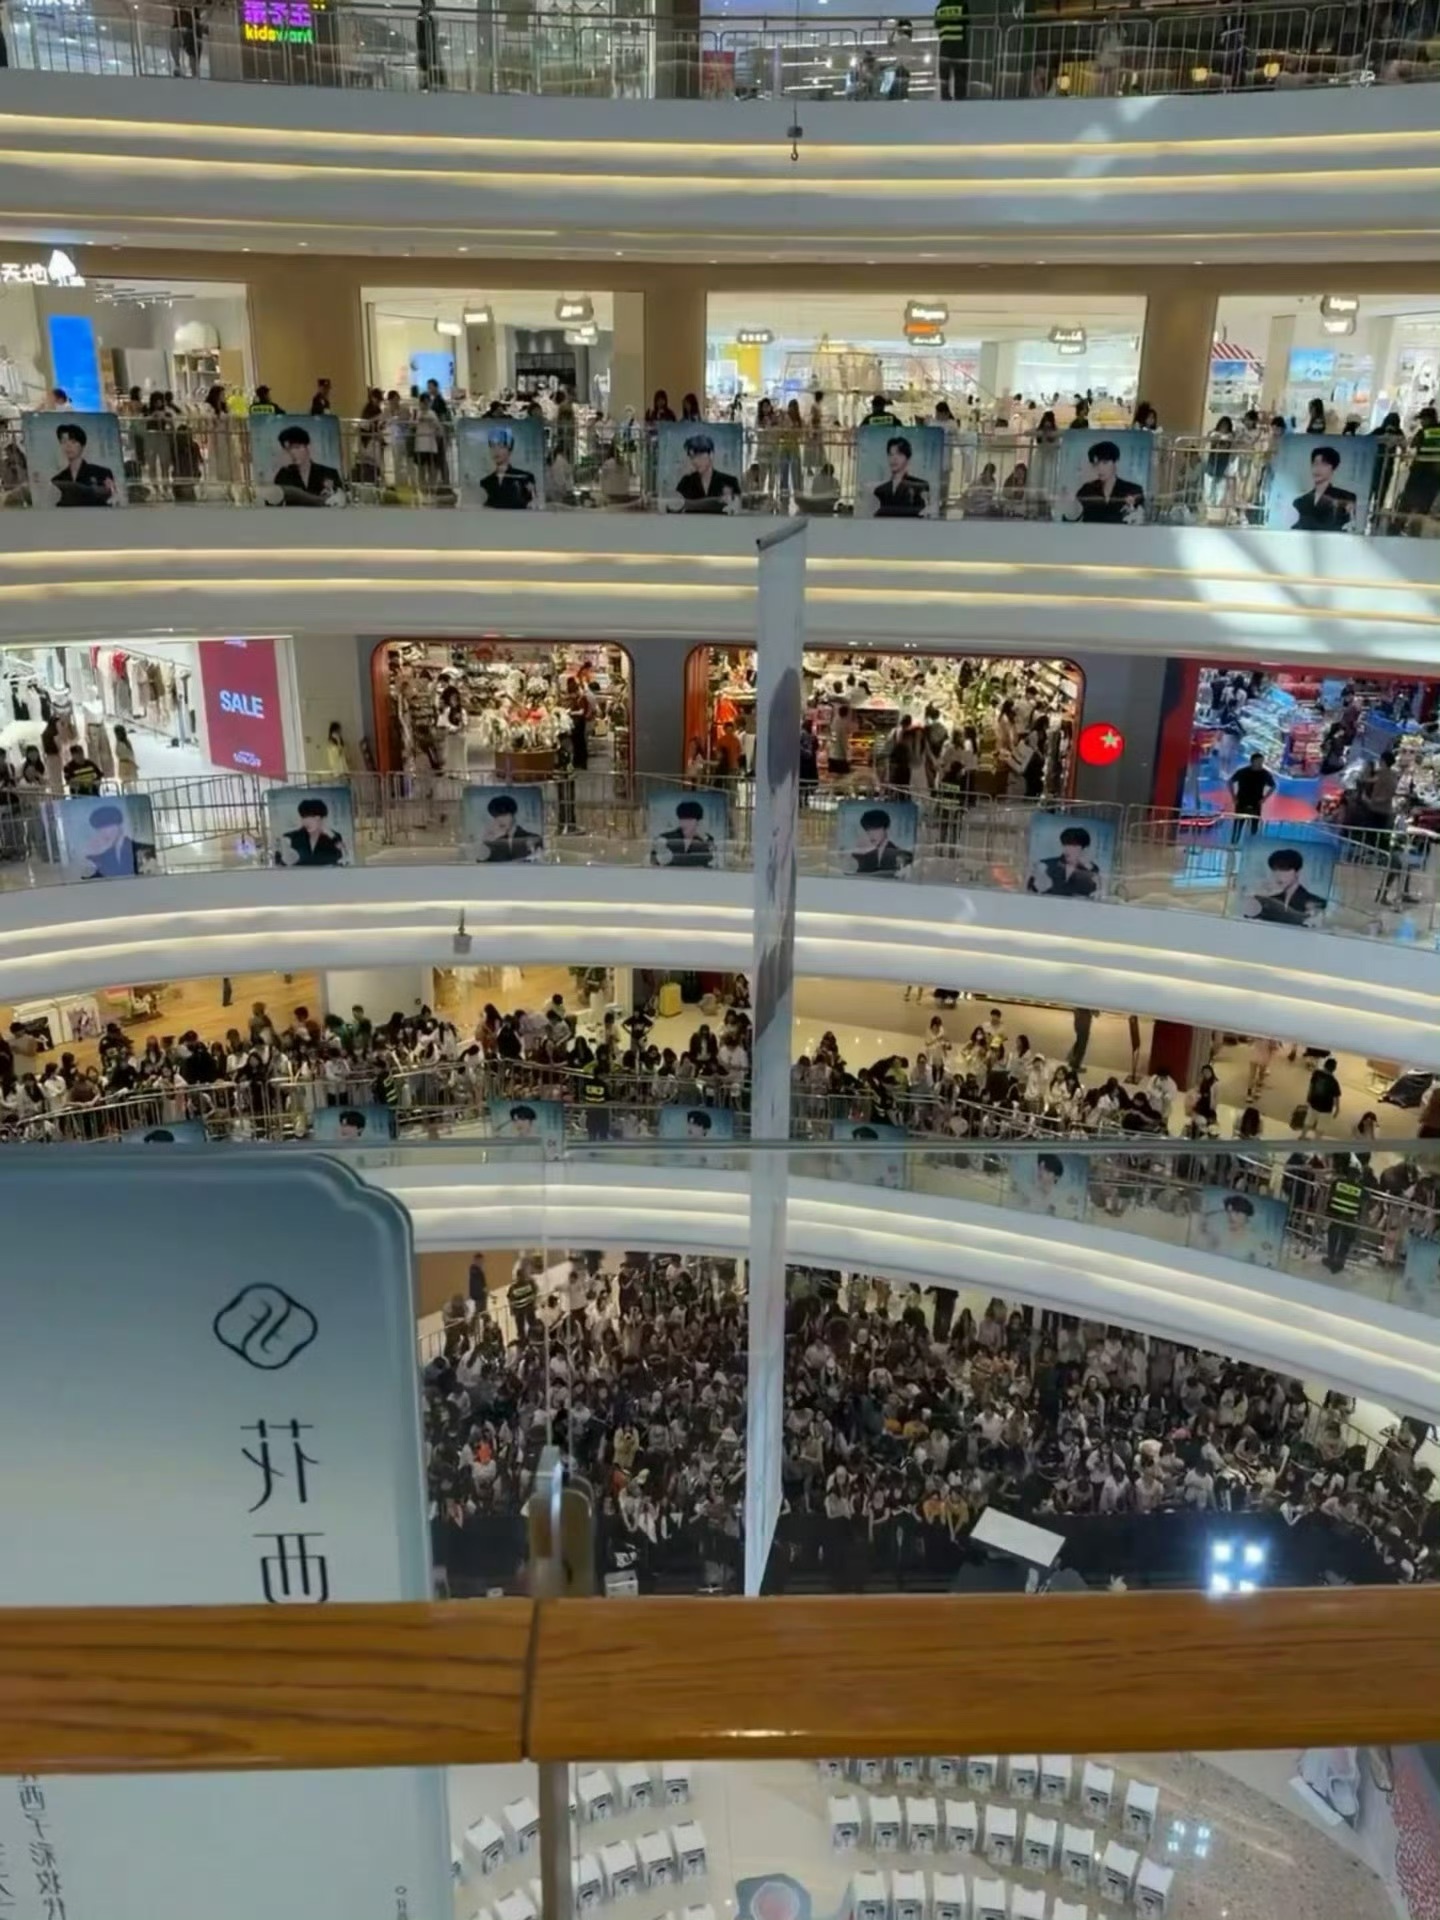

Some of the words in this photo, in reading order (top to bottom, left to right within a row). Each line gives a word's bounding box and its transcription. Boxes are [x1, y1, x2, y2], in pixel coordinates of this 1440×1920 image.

[244, 23, 314, 45] kidswant
[0, 262, 49, 285] 天地
[219, 689, 265, 719] SALE
